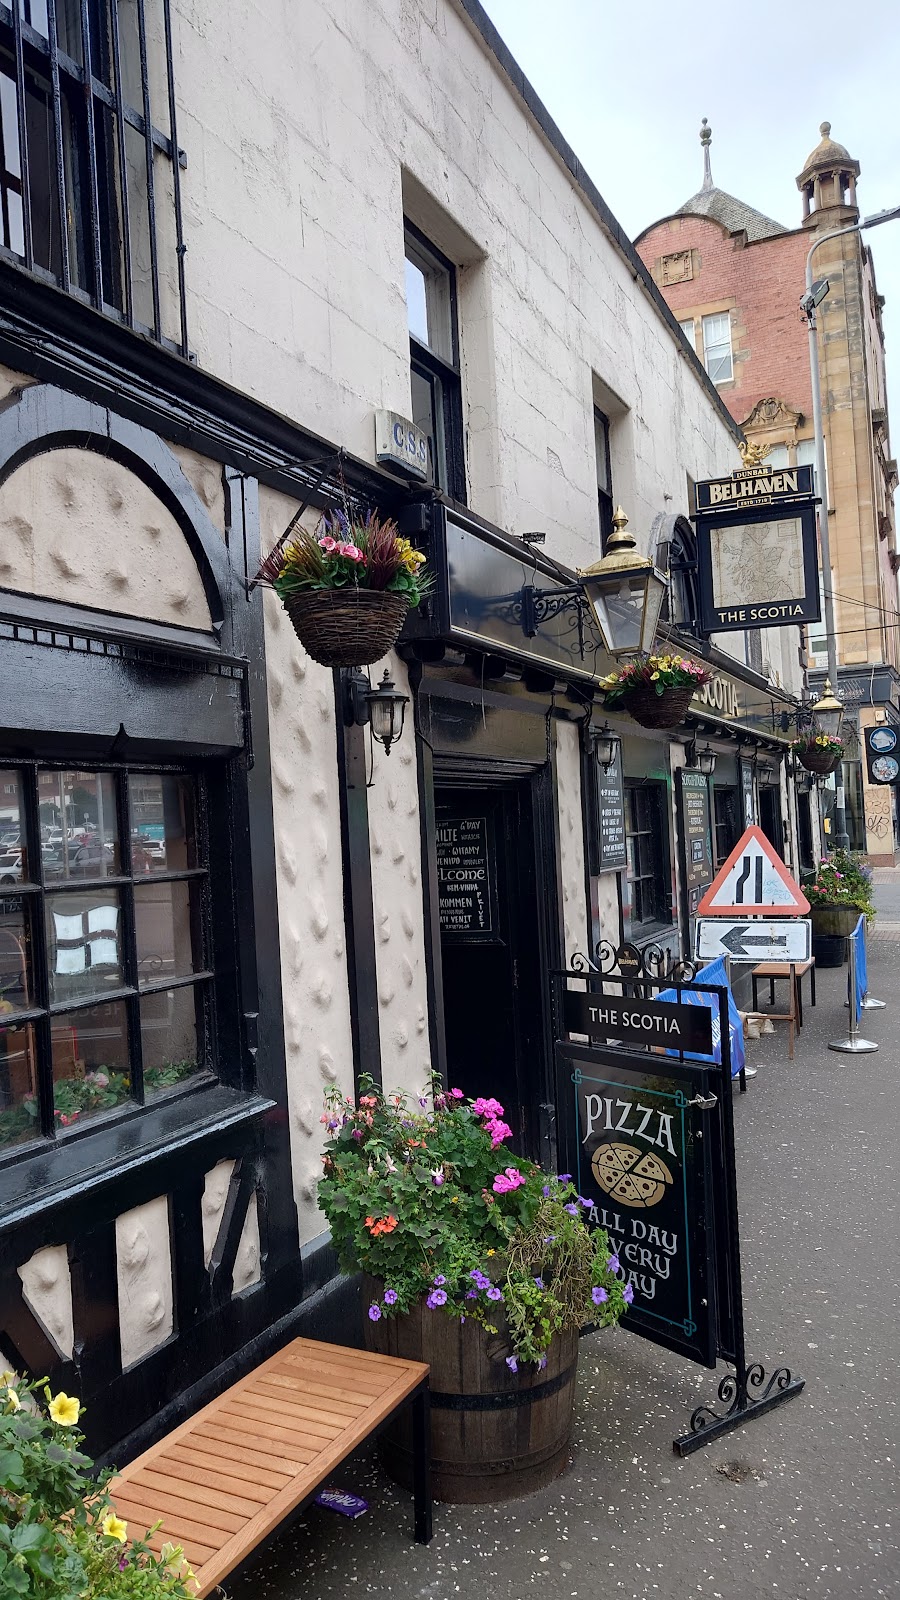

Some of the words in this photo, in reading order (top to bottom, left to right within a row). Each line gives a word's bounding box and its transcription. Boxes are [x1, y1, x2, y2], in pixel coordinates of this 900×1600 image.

[736, 468, 769, 479] DUNBAR
[709, 471, 798, 505] BELHAVEN
[718, 610, 746, 623] THE
[750, 605, 803, 620] SCOTIA
[436, 857, 460, 866] VENIDO
[440, 897, 472, 908] KOMMEN
[588, 1007, 618, 1025] THE
[622, 1012, 681, 1035] SCOTIA
[582, 1093, 677, 1158] PIZZA
[588, 1206, 625, 1235] ALL
[631, 1218, 677, 1256] DAY
[609, 1236, 670, 1279] VERY
